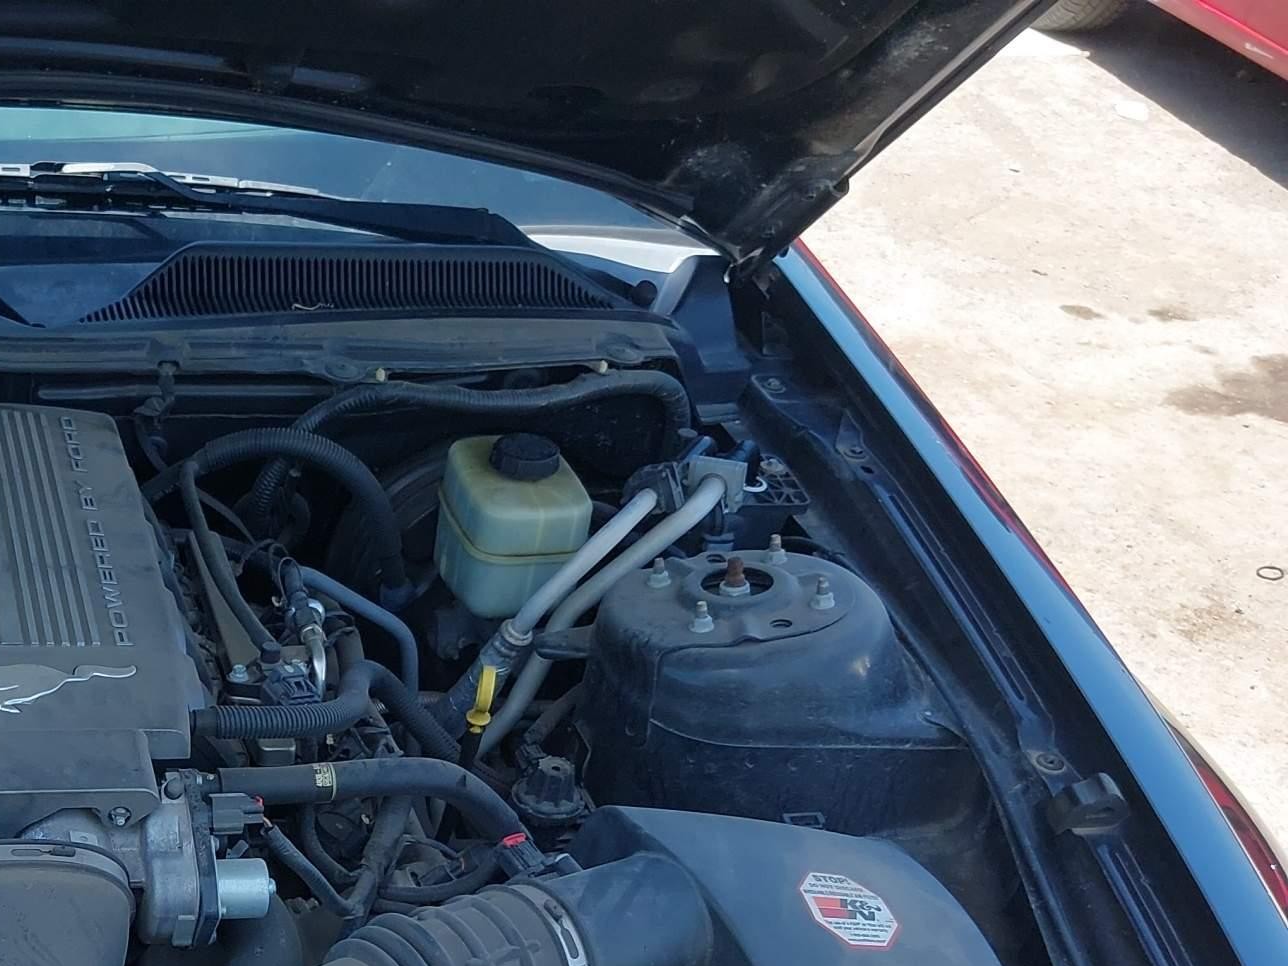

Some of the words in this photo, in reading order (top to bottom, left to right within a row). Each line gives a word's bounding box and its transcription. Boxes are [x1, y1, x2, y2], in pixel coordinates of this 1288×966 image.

[61, 416, 89, 473] FORD
[74, 480, 99, 510] BY
[87, 521, 134, 646] POWERED
